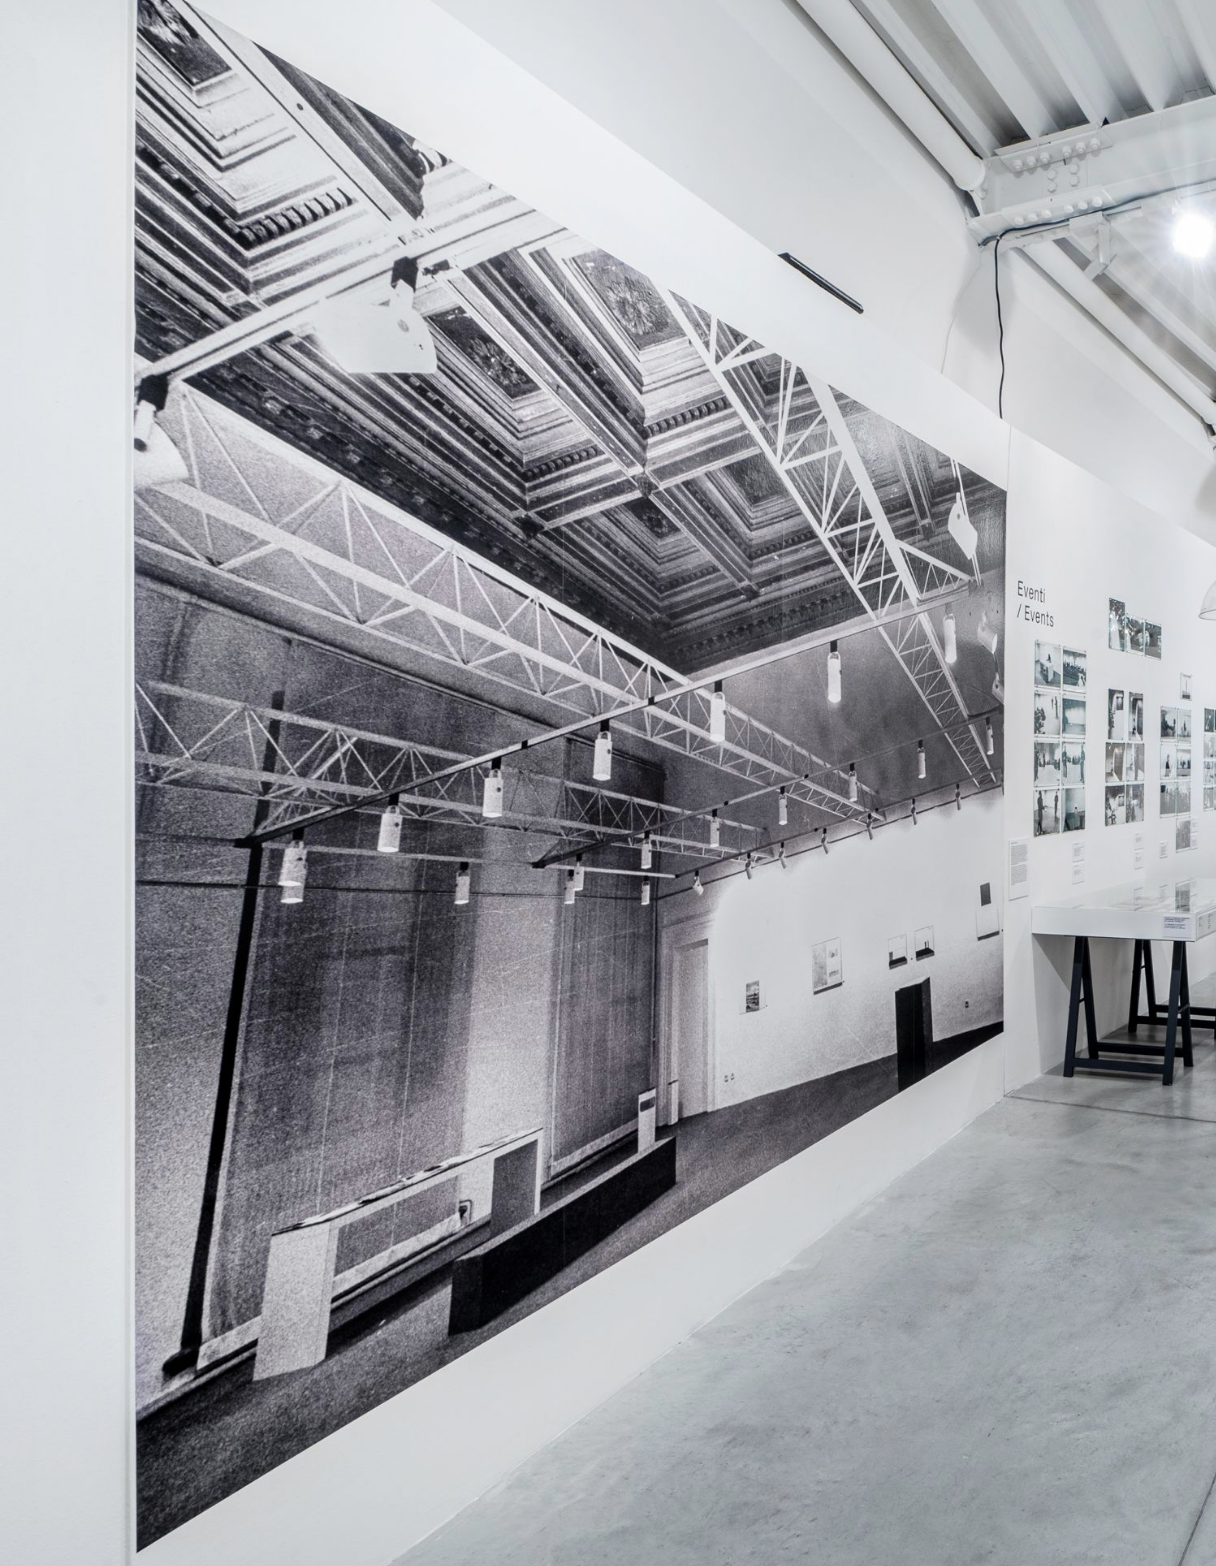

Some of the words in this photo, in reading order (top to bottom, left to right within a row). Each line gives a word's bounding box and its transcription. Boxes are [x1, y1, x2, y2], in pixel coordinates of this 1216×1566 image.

[1017, 580, 1046, 603] Eventi
[1016, 603, 1022, 618] /
[1024, 605, 1055, 628] Events
